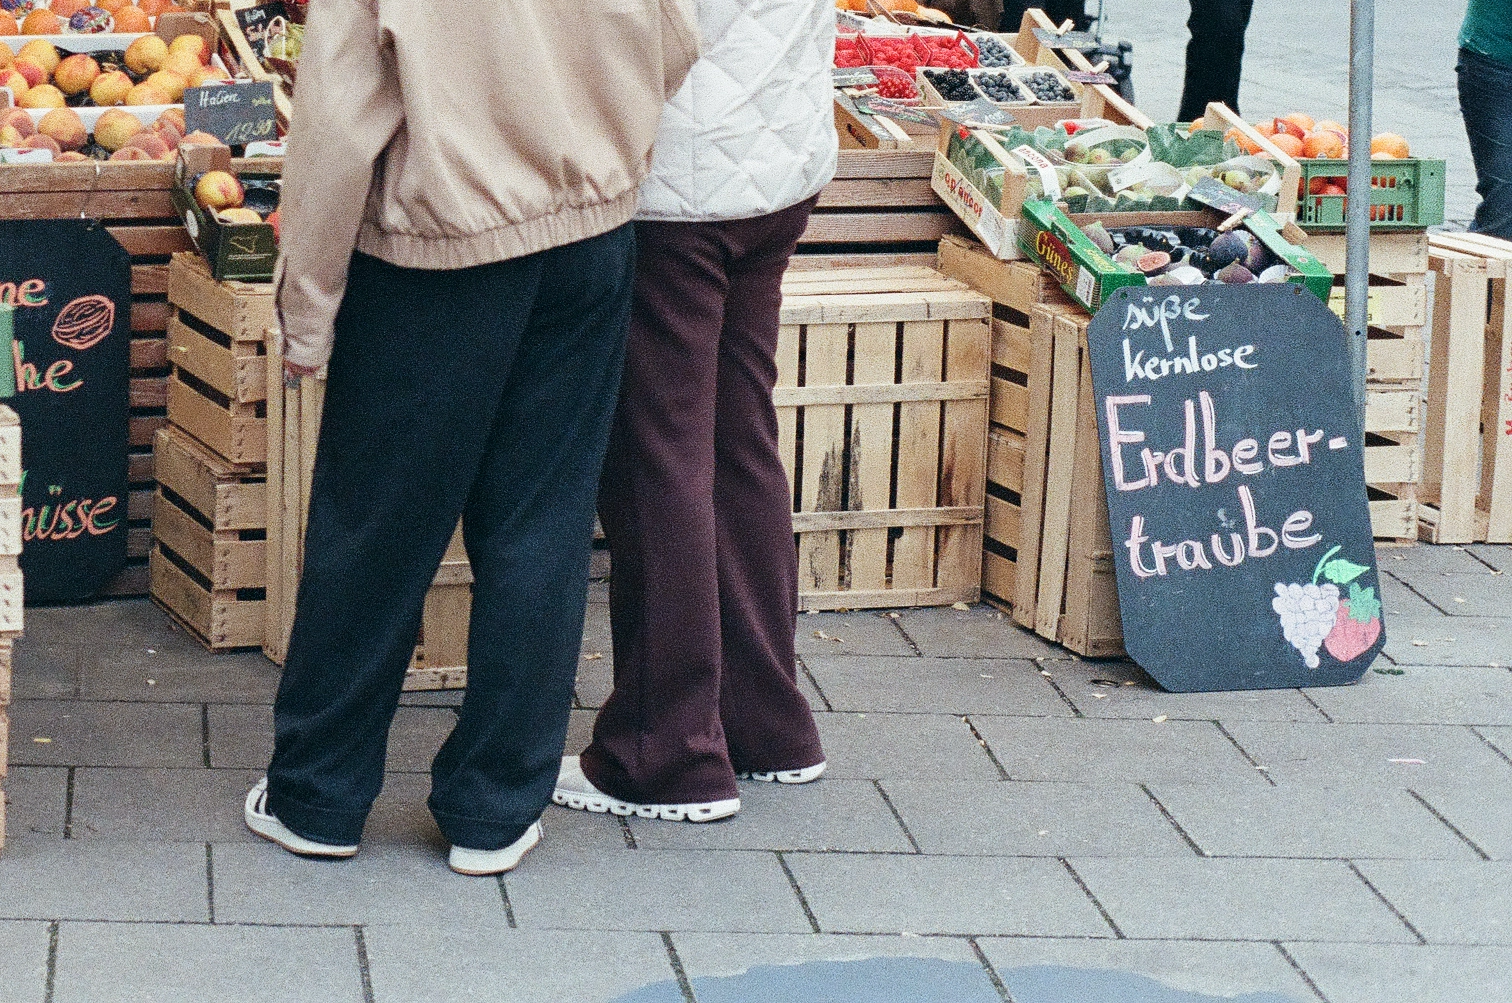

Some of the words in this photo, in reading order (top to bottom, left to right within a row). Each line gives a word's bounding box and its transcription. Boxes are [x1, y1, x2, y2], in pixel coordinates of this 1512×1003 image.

[1122, 294, 1210, 352] süße
[1122, 336, 1259, 383] kernlose
[1105, 391, 1350, 492] Erdbeer-
[1124, 485, 1323, 579] traube
